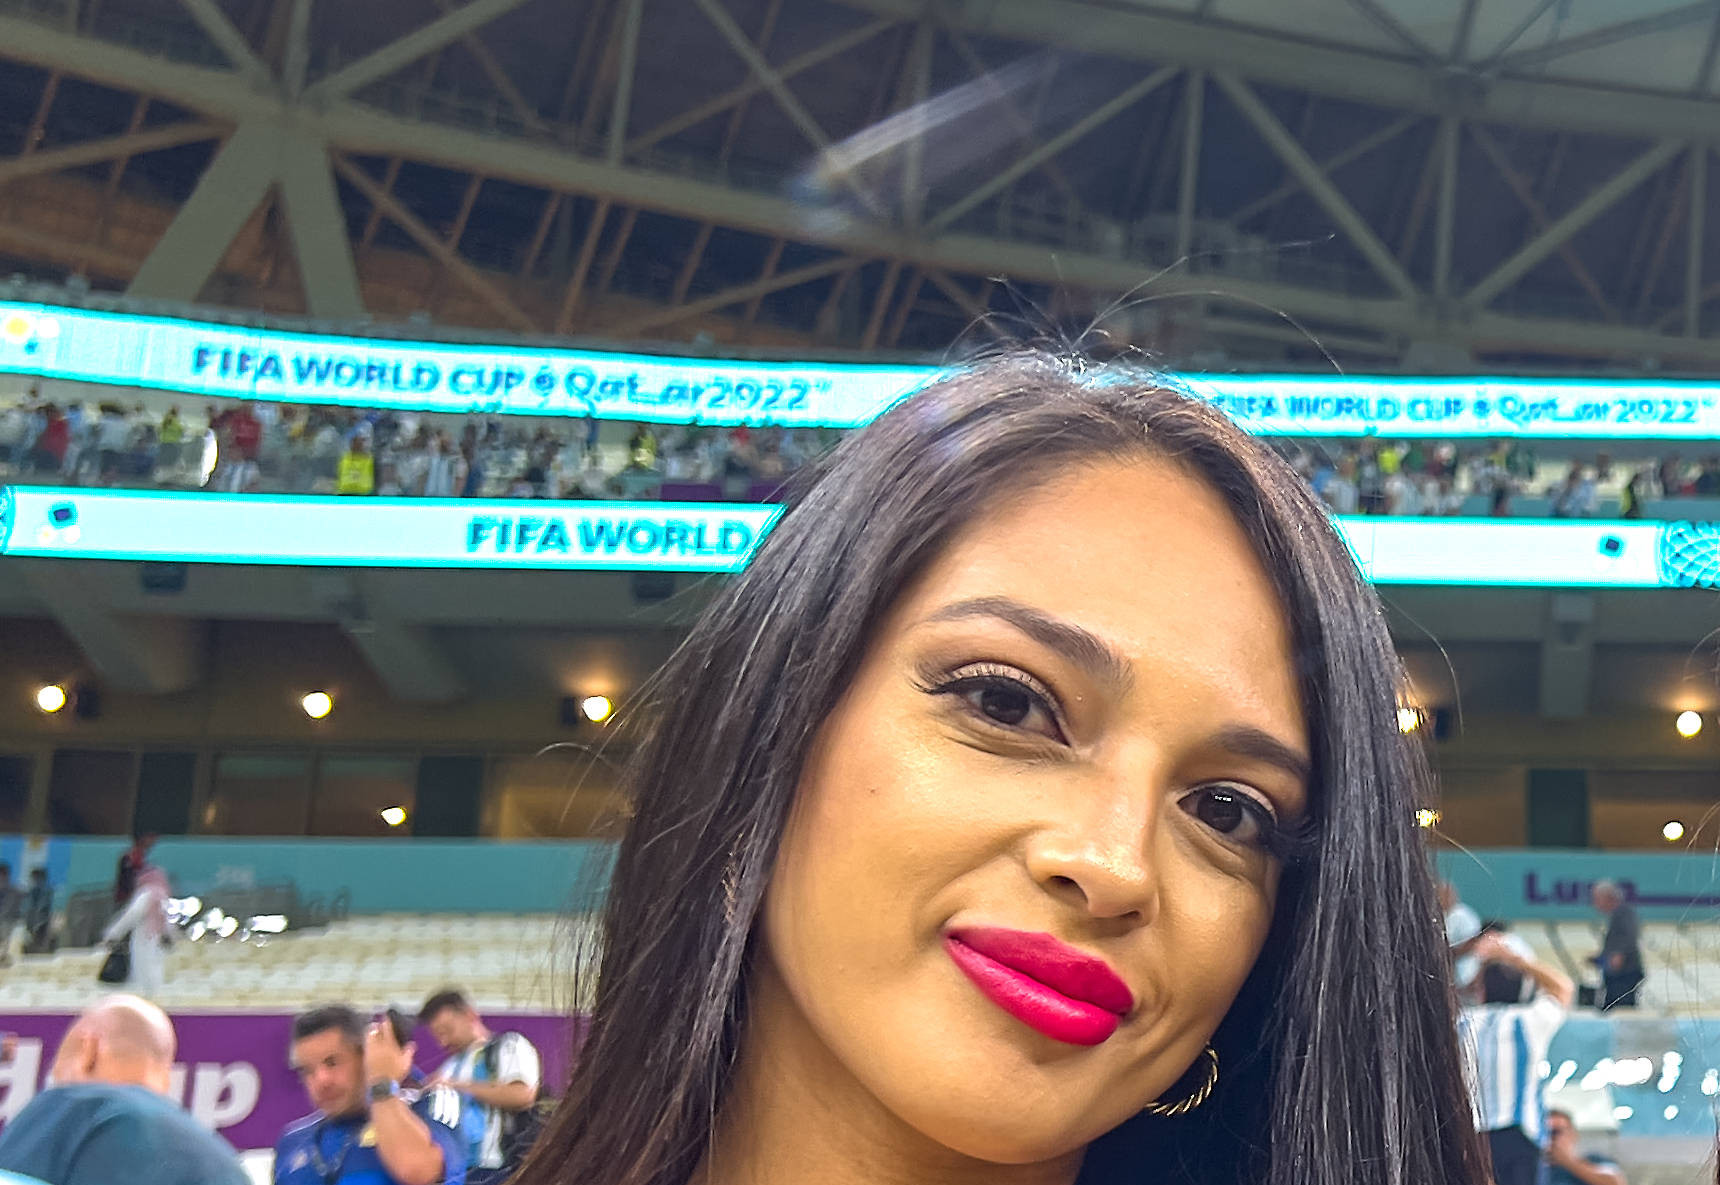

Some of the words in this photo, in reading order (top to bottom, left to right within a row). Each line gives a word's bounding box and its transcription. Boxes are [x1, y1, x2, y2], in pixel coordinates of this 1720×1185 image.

[192, 342, 284, 383] FIFA
[293, 355, 440, 392] WORLD
[449, 364, 524, 396] CUP
[1286, 395, 1398, 421] WORLD
[1407, 398, 1464, 421] CUP
[465, 515, 573, 553] FIFA
[576, 517, 752, 554] WORLD
